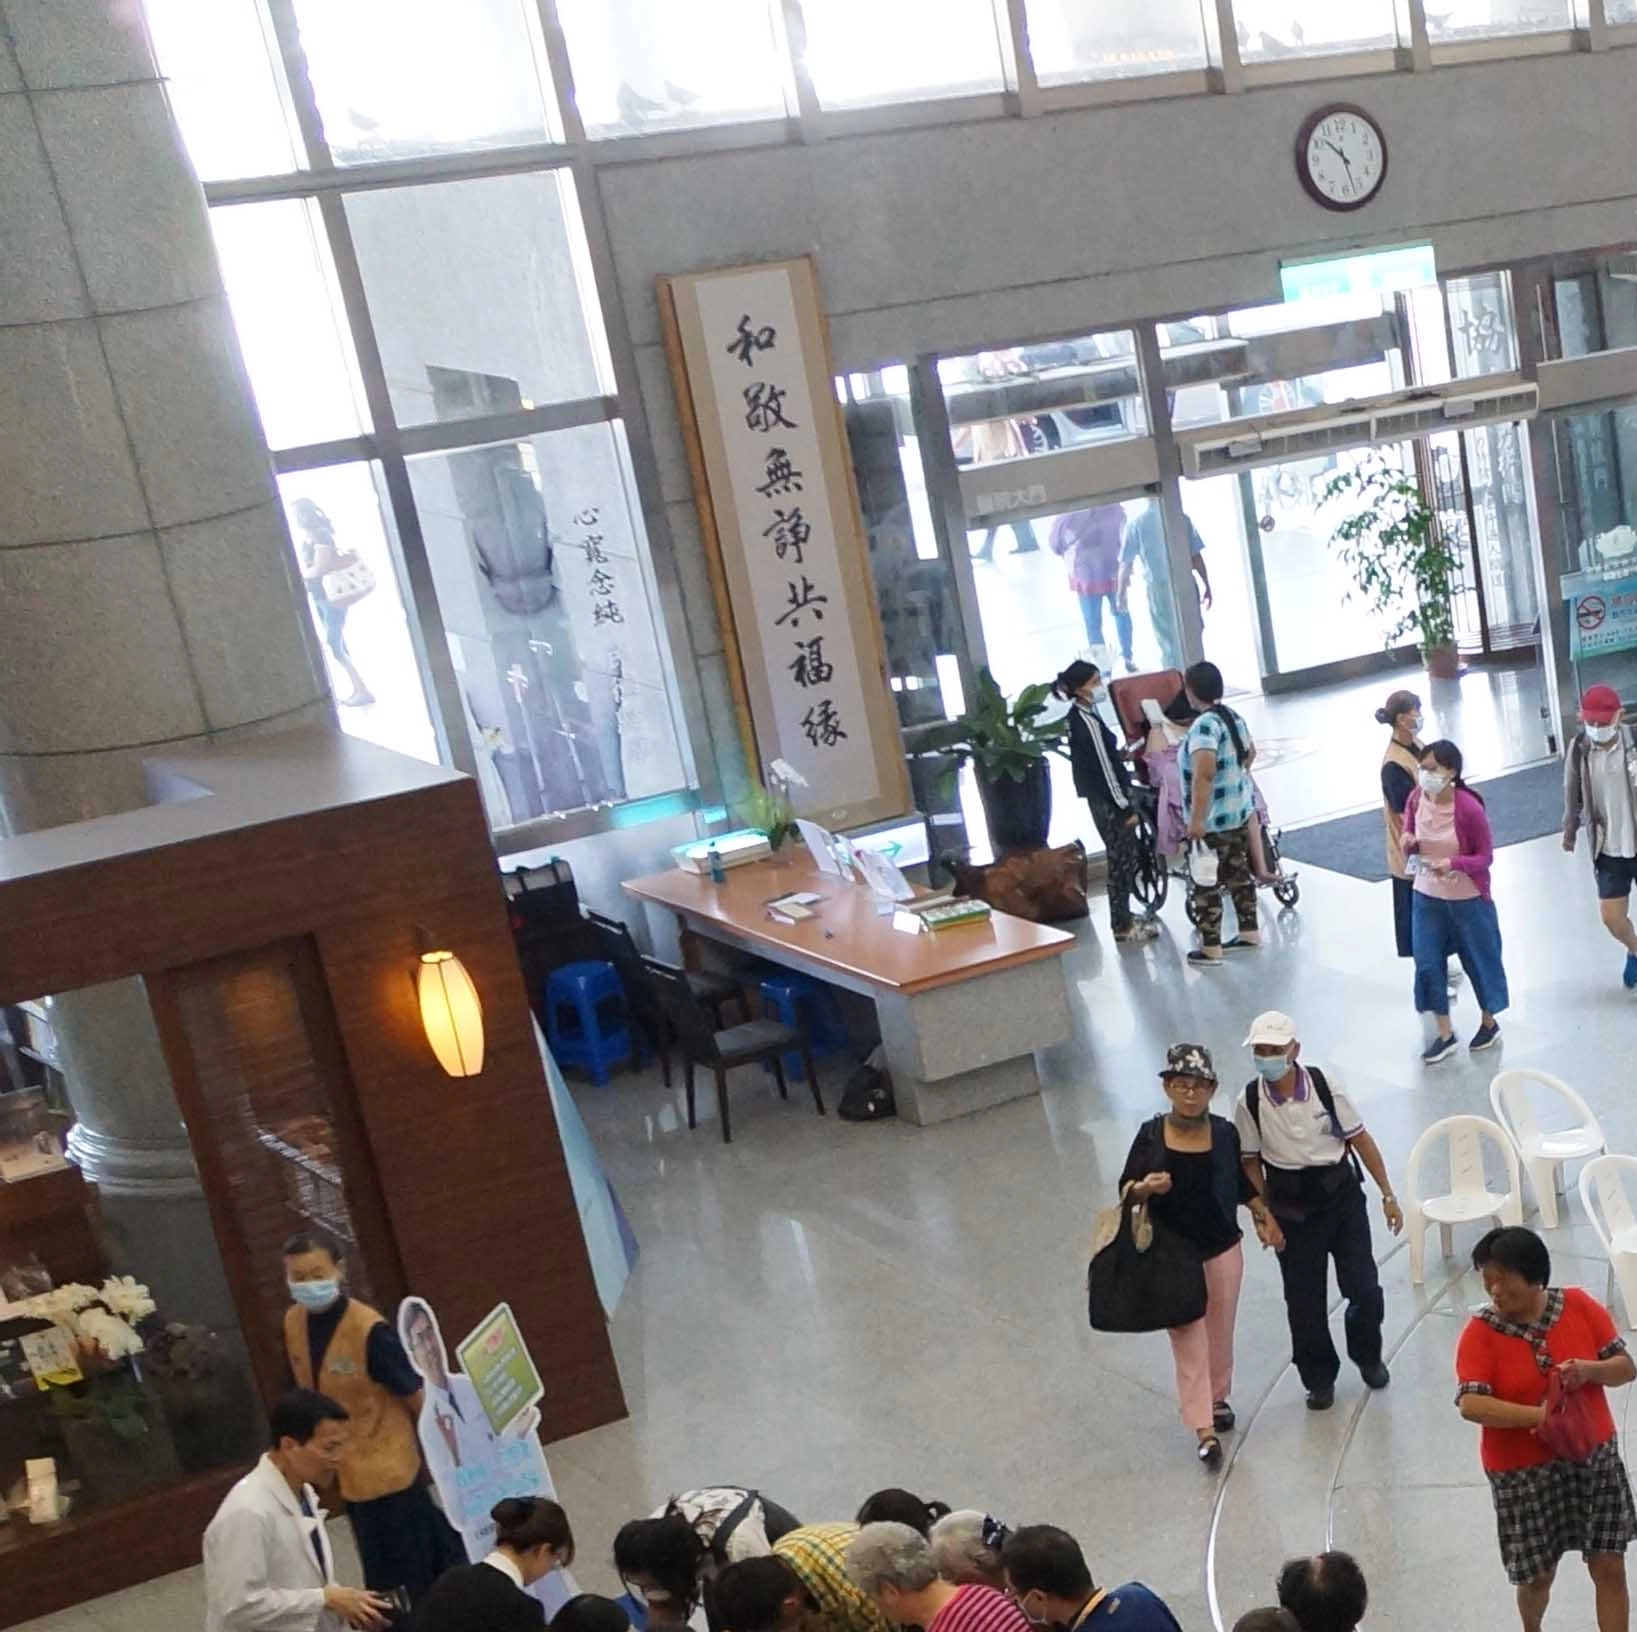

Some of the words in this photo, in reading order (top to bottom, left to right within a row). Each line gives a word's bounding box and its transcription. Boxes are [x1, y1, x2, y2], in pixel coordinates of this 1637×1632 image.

[726, 313, 848, 748] 和敬無諍共福緣
